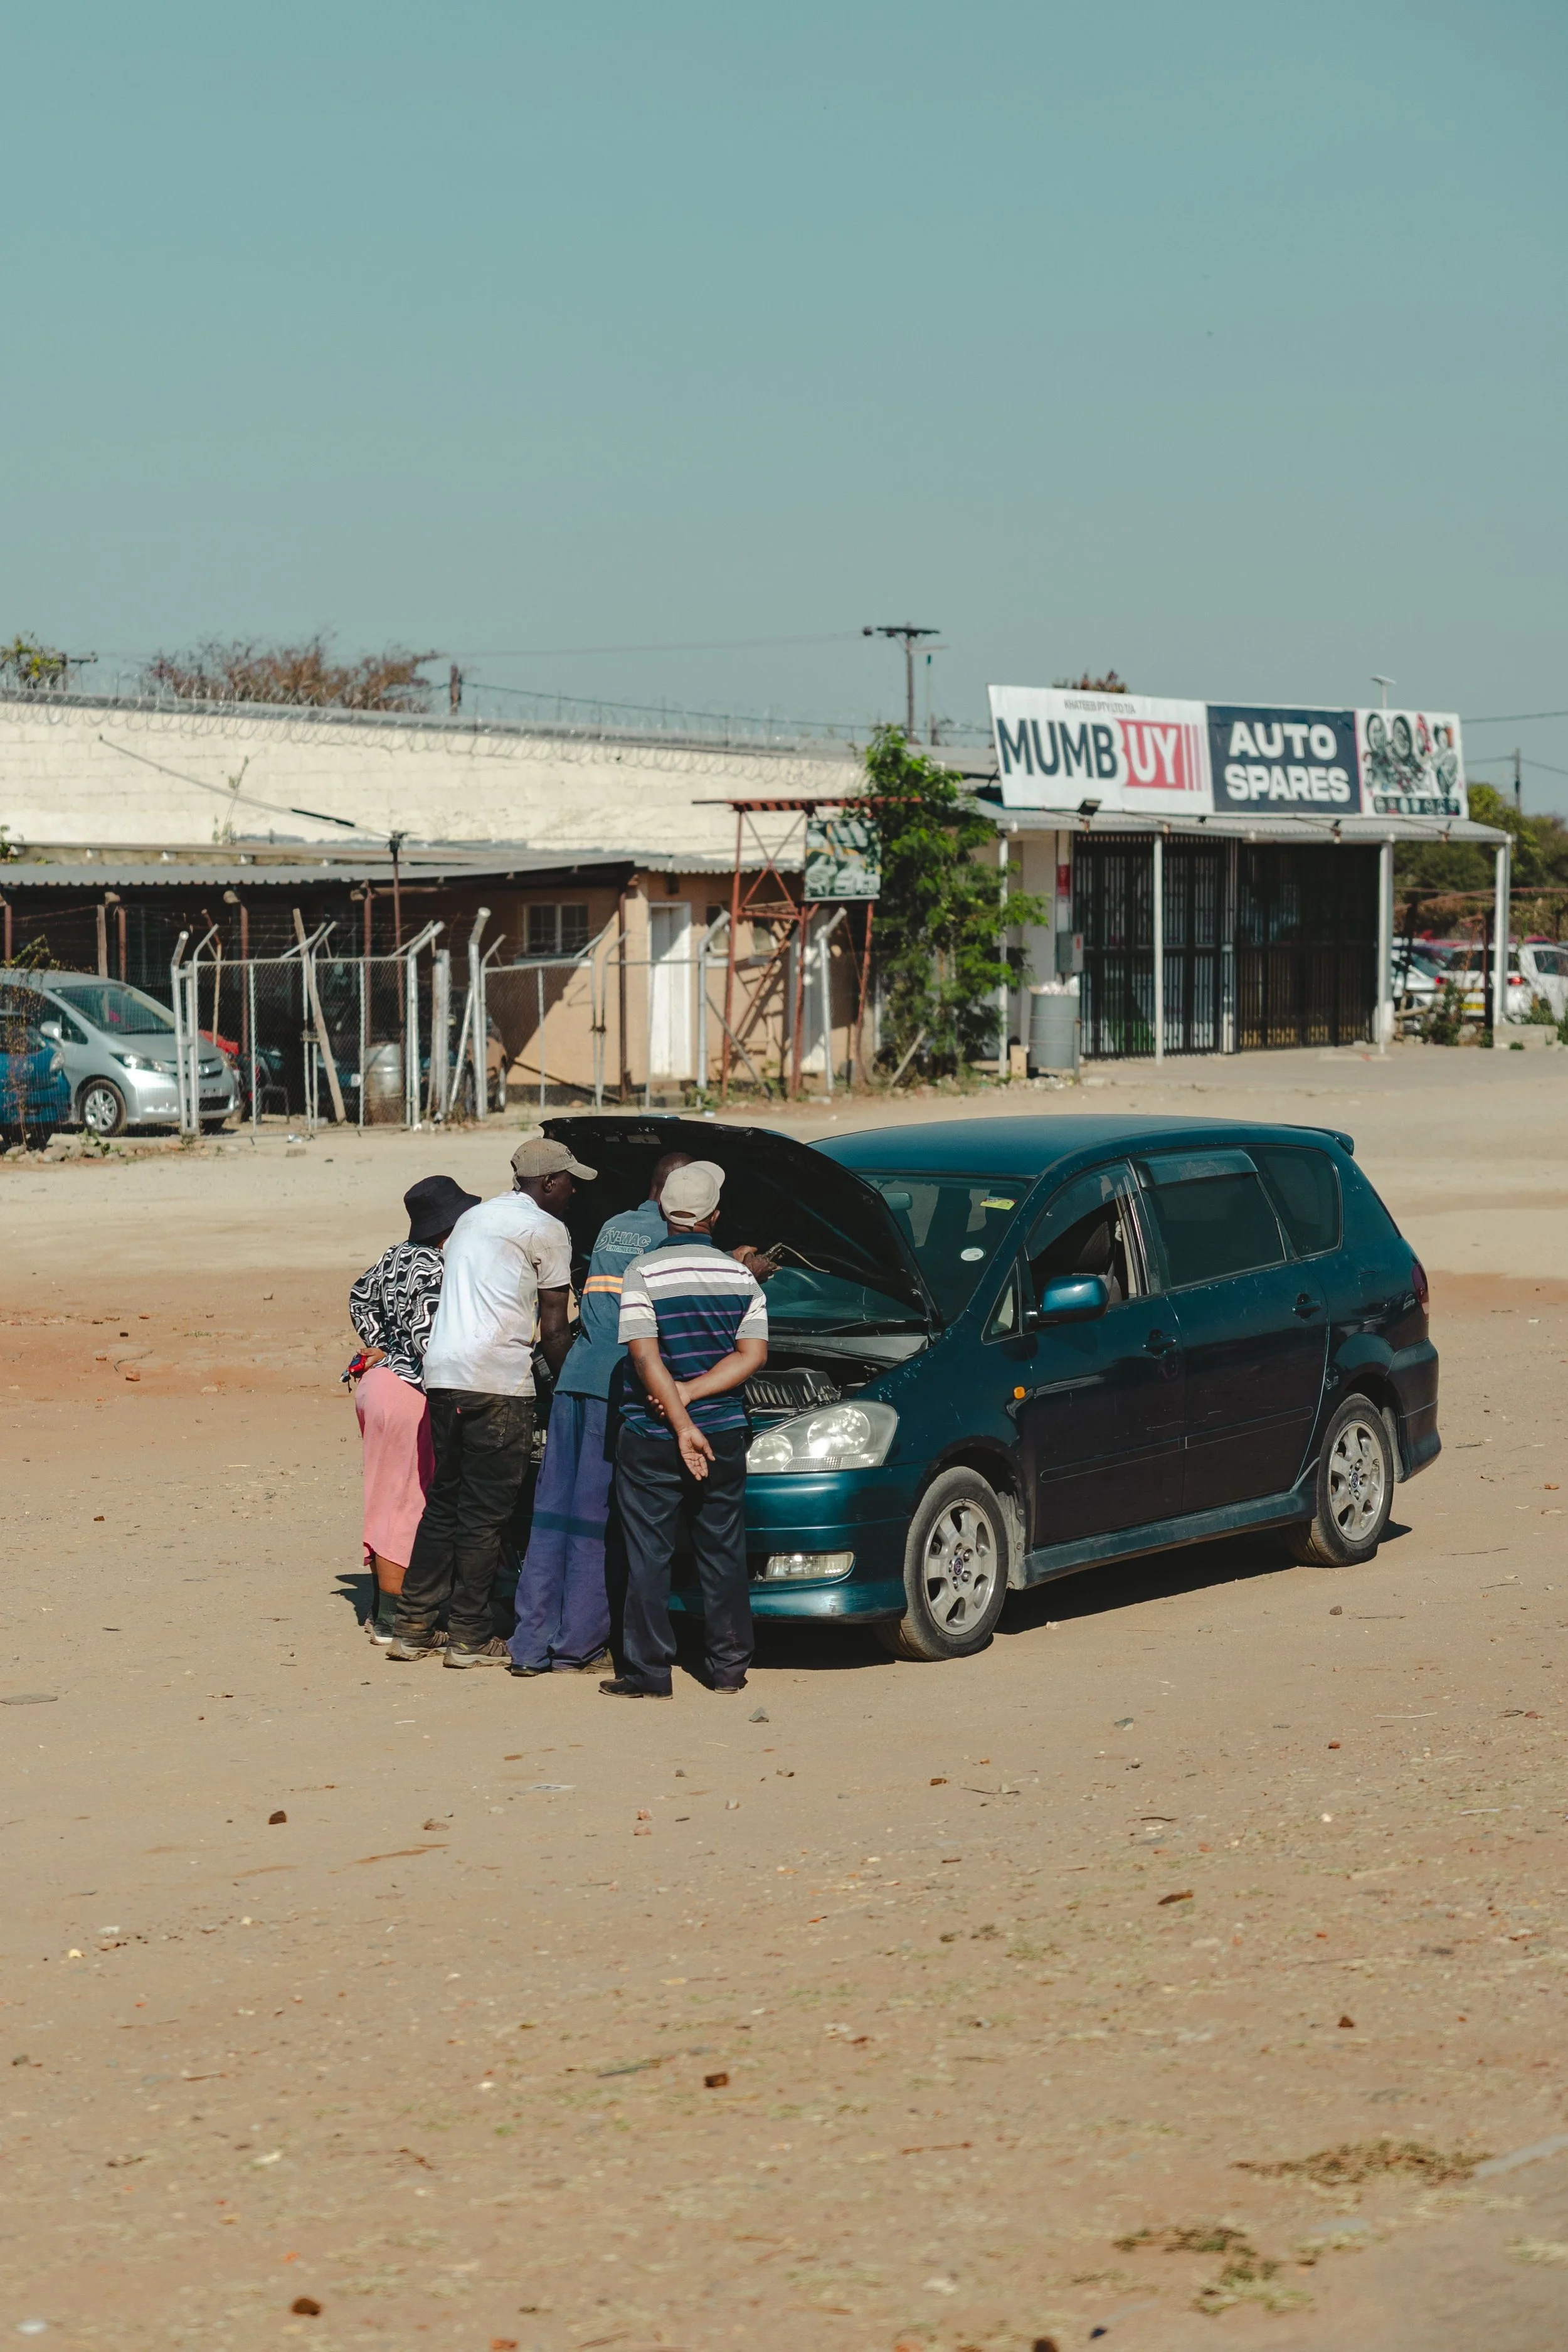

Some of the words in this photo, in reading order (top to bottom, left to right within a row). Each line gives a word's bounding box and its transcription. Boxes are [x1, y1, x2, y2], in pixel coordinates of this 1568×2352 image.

[1229, 721, 1337, 760] AUTO
[1224, 763, 1351, 803] SPARES
[607, 1245, 644, 1254] ENGINEERING
[610, 1231, 652, 1247] V-MAC
